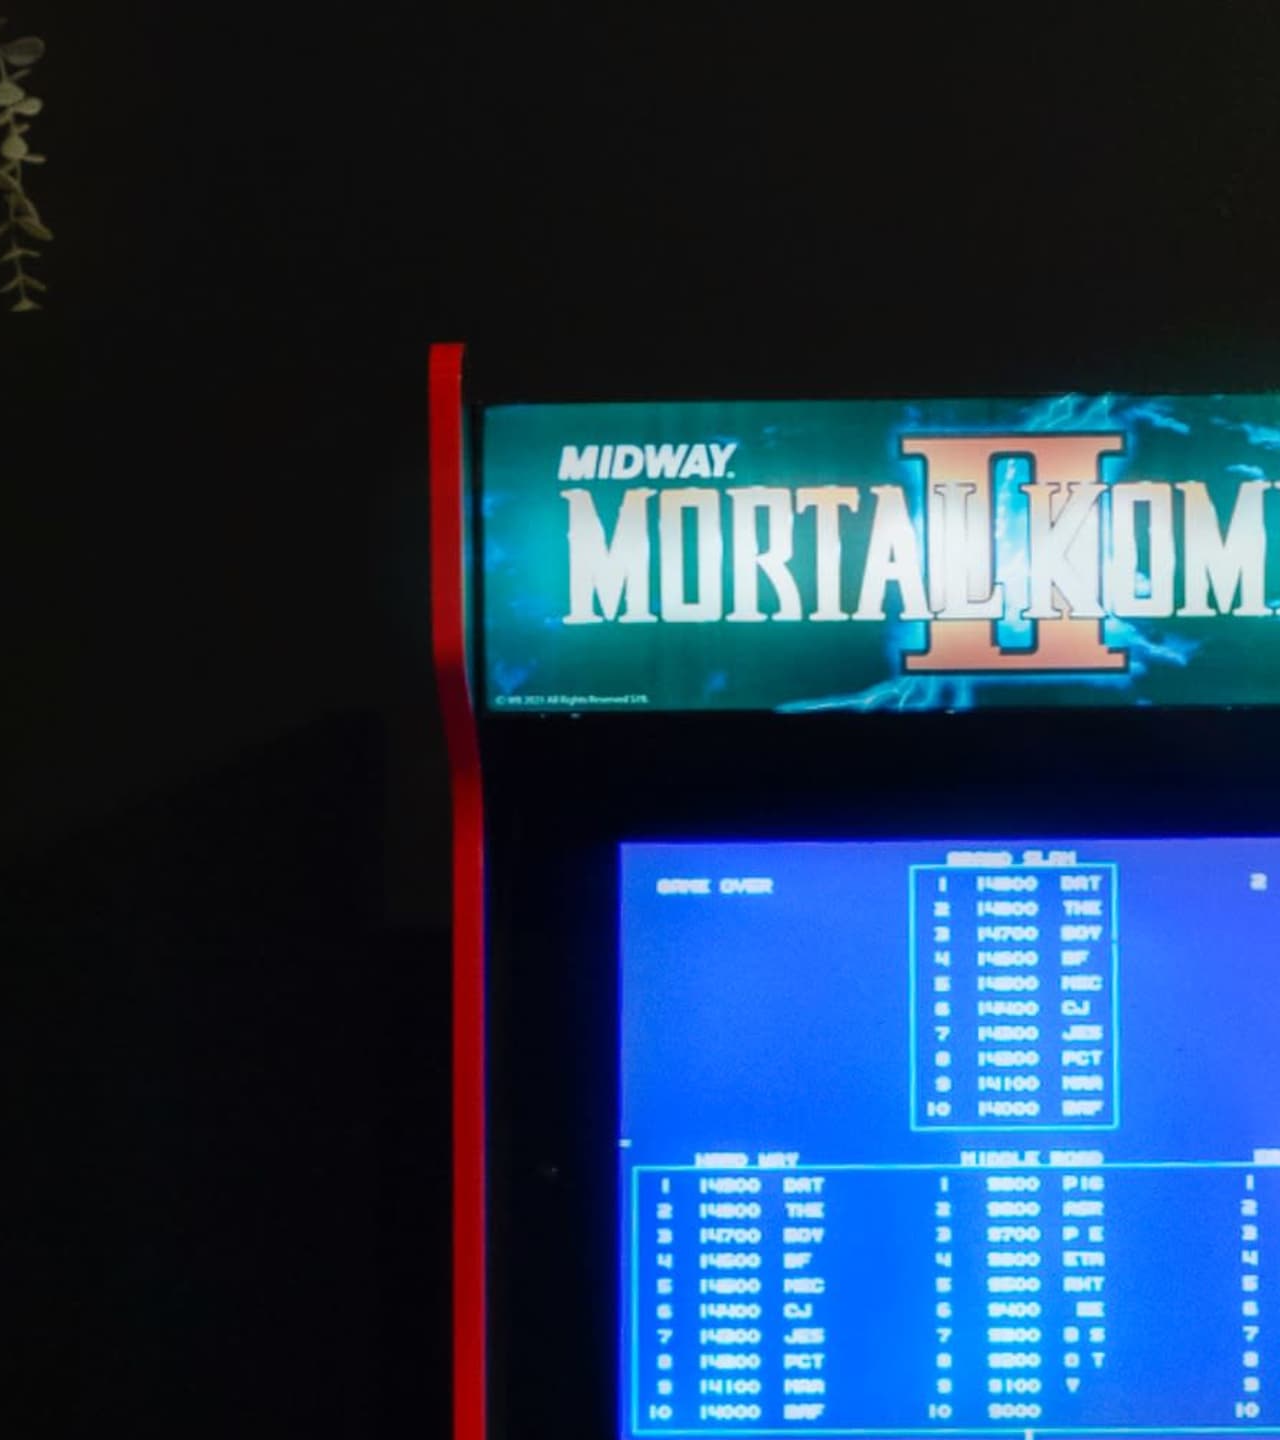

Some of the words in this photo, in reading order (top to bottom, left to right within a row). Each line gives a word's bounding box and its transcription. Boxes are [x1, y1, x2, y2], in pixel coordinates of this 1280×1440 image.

[559, 481, 1004, 624] MORTAL
[938, 874, 947, 893] 1
[1249, 872, 1268, 891] 2
[933, 899, 951, 917] 2
[934, 949, 951, 967] 4
[1060, 999, 1090, 1017] CJ
[934, 1024, 951, 1042] 7
[926, 1099, 952, 1117] 10
[660, 1175, 671, 1195] 1
[939, 1175, 949, 1193] 1
[1245, 1172, 1254, 1191] 1
[656, 1200, 674, 1220] 2
[935, 1199, 952, 1218] 2
[1240, 1198, 1258, 1217] 2
[1062, 1225, 1080, 1244] P
[656, 1251, 673, 1270] 4
[934, 1250, 953, 1268] 4
[1241, 1247, 1259, 1266] 4
[782, 1301, 813, 1320] CJ
[656, 1327, 674, 1346] 7
[935, 1325, 953, 1344] 7
[1242, 1324, 1260, 1343] 7
[1091, 1351, 1106, 1369] T
[648, 1402, 674, 1421] 10
[928, 1402, 953, 1420] 10
[1235, 1400, 1261, 1419] 10
